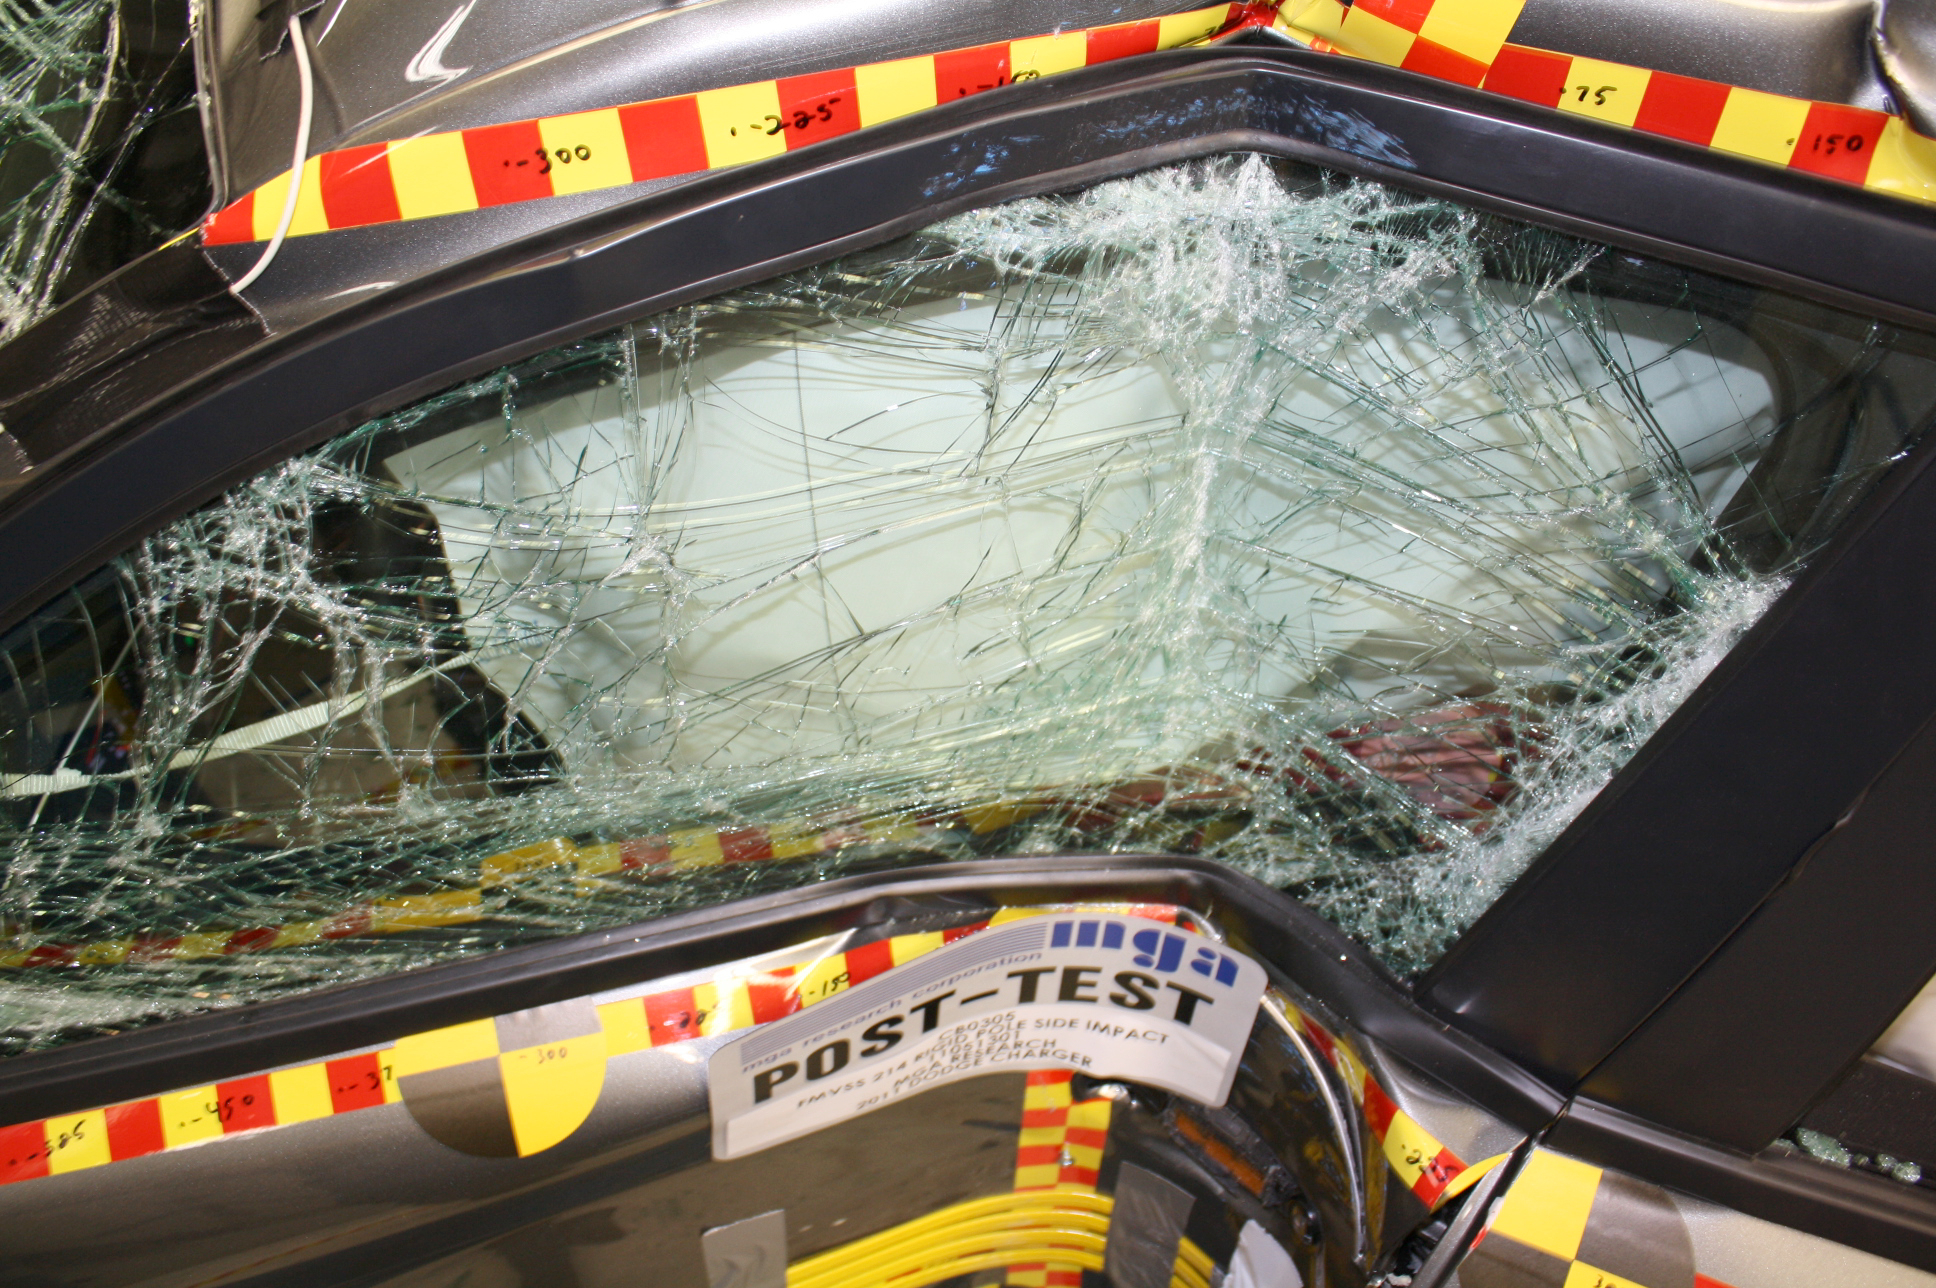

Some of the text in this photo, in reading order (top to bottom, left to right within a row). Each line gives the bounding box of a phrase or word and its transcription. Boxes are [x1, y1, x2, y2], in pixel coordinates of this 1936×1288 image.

[1576, 85, 1618, 106] 75
[750, 97, 842, 136] -225
[515, 143, 592, 175] -300
[1812, 133, 1864, 156] 150
[1050, 919, 1240, 988] mga
[742, 951, 1042, 1074] mga research corporation
[939, 1011, 1017, 1040] CB0305
[753, 965, 1215, 1104] POST-TEST
[517, 1046, 569, 1065] -300
[797, 1017, 1170, 1109] FMVSS 214 RIGID POLE SIDE IMPACT
[893, 1038, 1057, 1087] MGA RESEARCH
[857, 1047, 1093, 1111] 2011 DODGE CHARGER
[191, 1093, 255, 1124] -450
